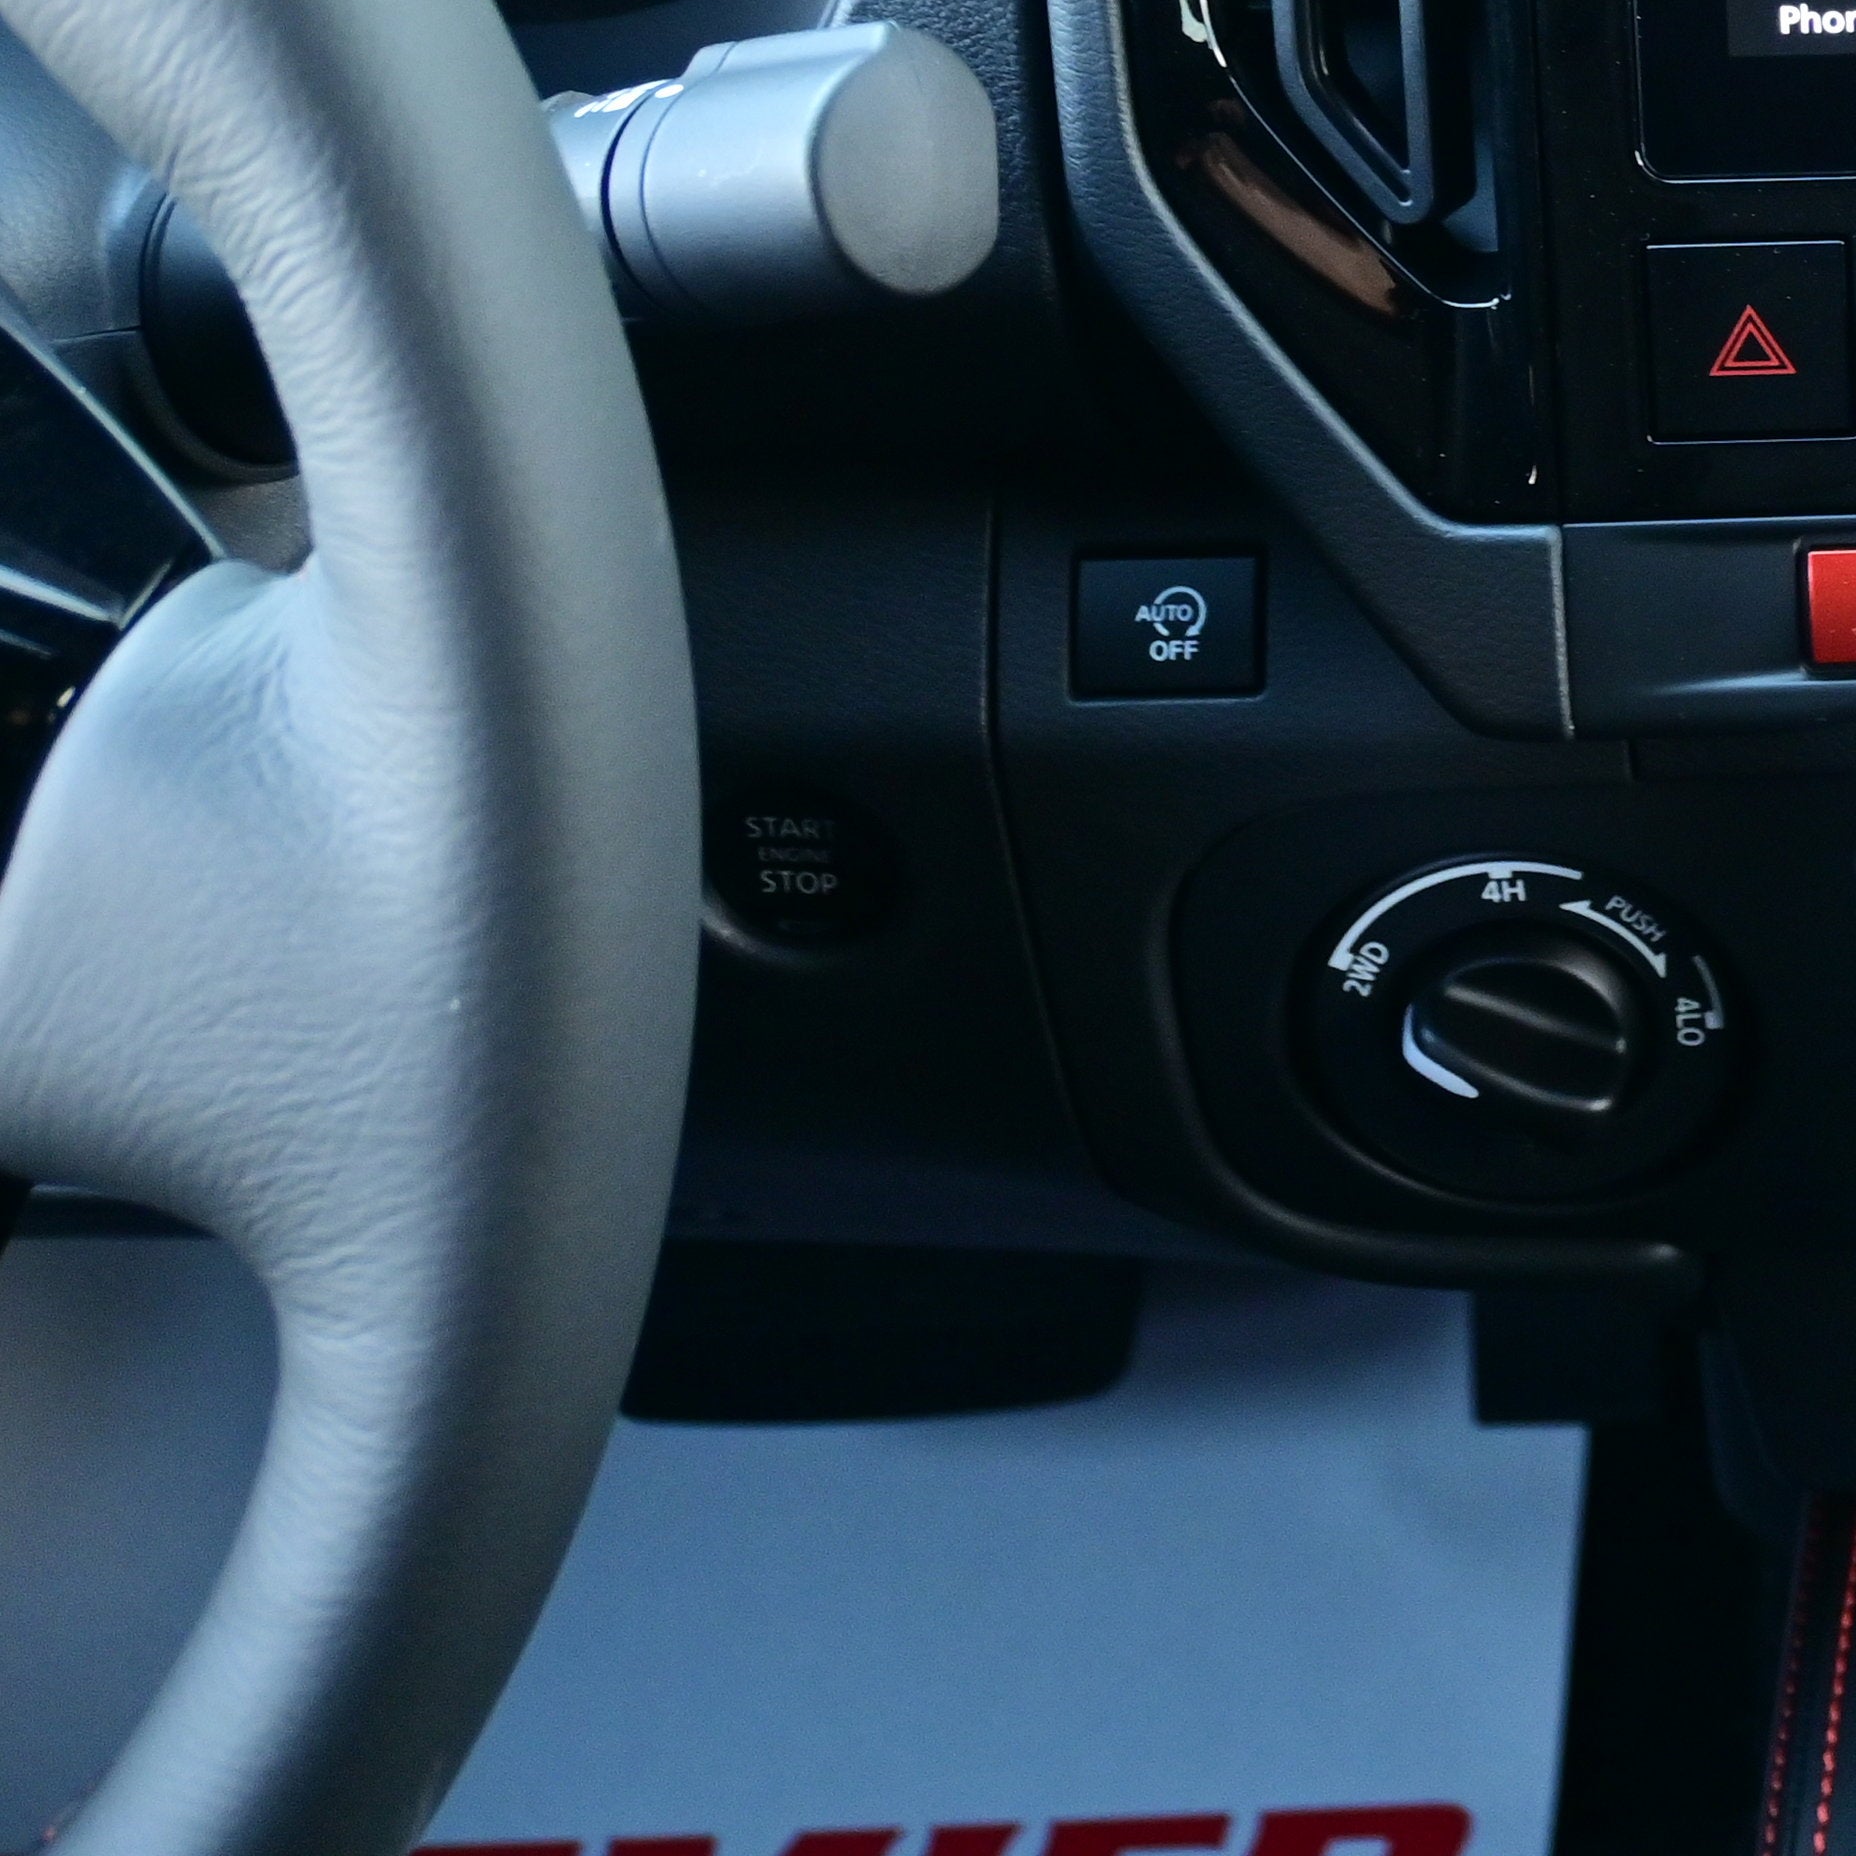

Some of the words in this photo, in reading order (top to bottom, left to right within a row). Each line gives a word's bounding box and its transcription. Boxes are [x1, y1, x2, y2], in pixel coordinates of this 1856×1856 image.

[1135, 603, 1194, 624] AUTO
[1149, 639, 1199, 663] OFF
[744, 816, 837, 841] START
[759, 869, 839, 895] STOP
[1480, 879, 1527, 903] 4H
[1604, 894, 1668, 944] PUSH
[1343, 941, 1390, 998] 2WD
[1675, 996, 1706, 1047] 4LO
